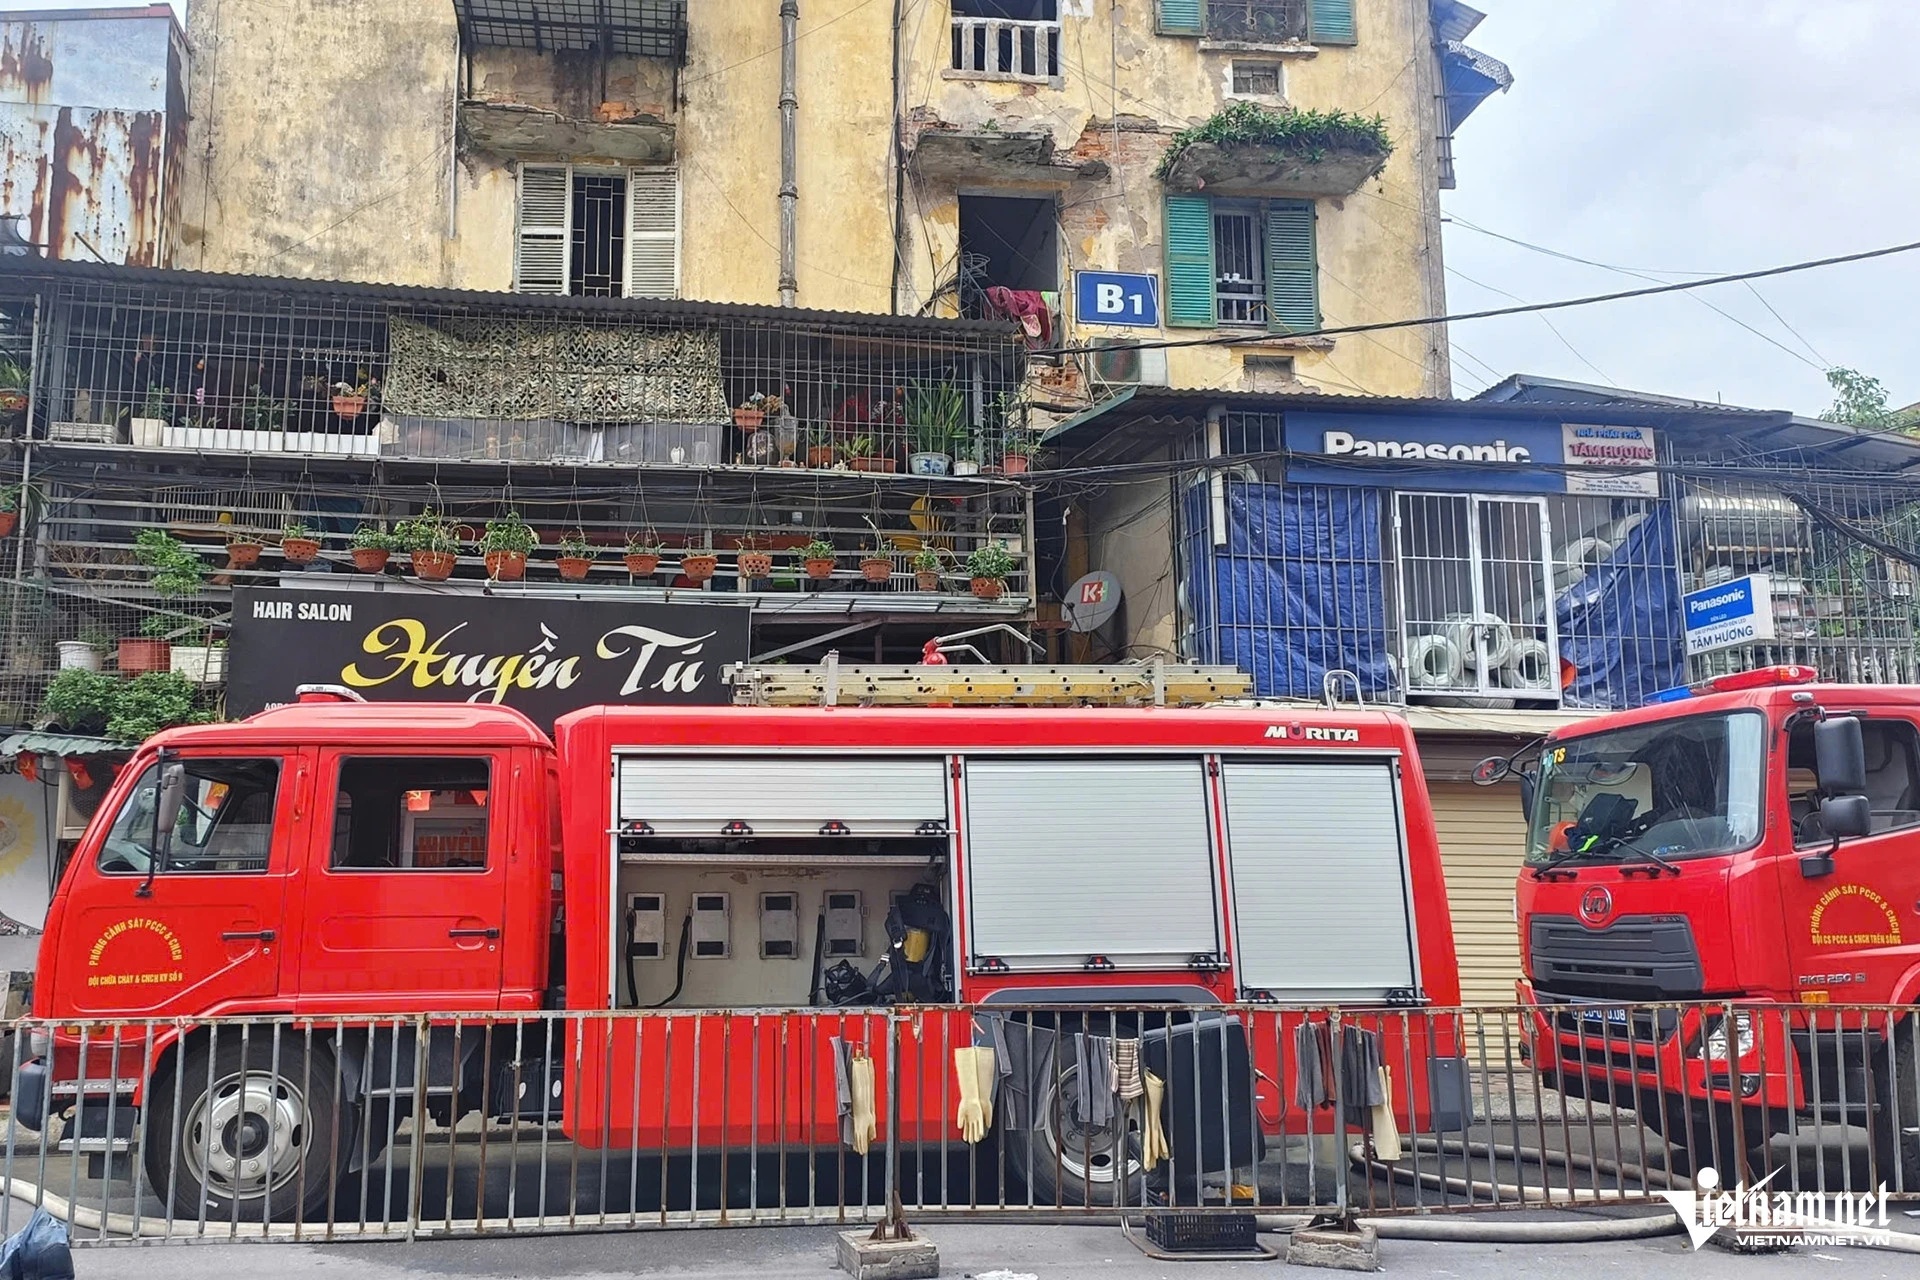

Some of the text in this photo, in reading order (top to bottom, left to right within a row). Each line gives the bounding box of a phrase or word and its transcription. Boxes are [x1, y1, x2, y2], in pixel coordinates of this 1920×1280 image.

[1097, 283, 1142, 315] B1
[1323, 431, 1531, 463] Panasonic
[1083, 583, 1106, 602] K+
[1691, 589, 1745, 613] Panasonic
[253, 601, 352, 621] HAIR SALON
[1691, 625, 1754, 649] TÂM HƯƠNG
[341, 618, 717, 704] Huyền Tú
[1264, 721, 1359, 741] MORITA
[1841, 884, 1857, 894] SÁT
[1859, 887, 1881, 903] PCCC
[1880, 902, 1888, 910] &
[1886, 909, 1900, 934] CNCH
[127, 917, 144, 929] SÁT
[145, 919, 167, 935] PCCC
[164, 931, 173, 940] &
[168, 938, 183, 960] CNCH
